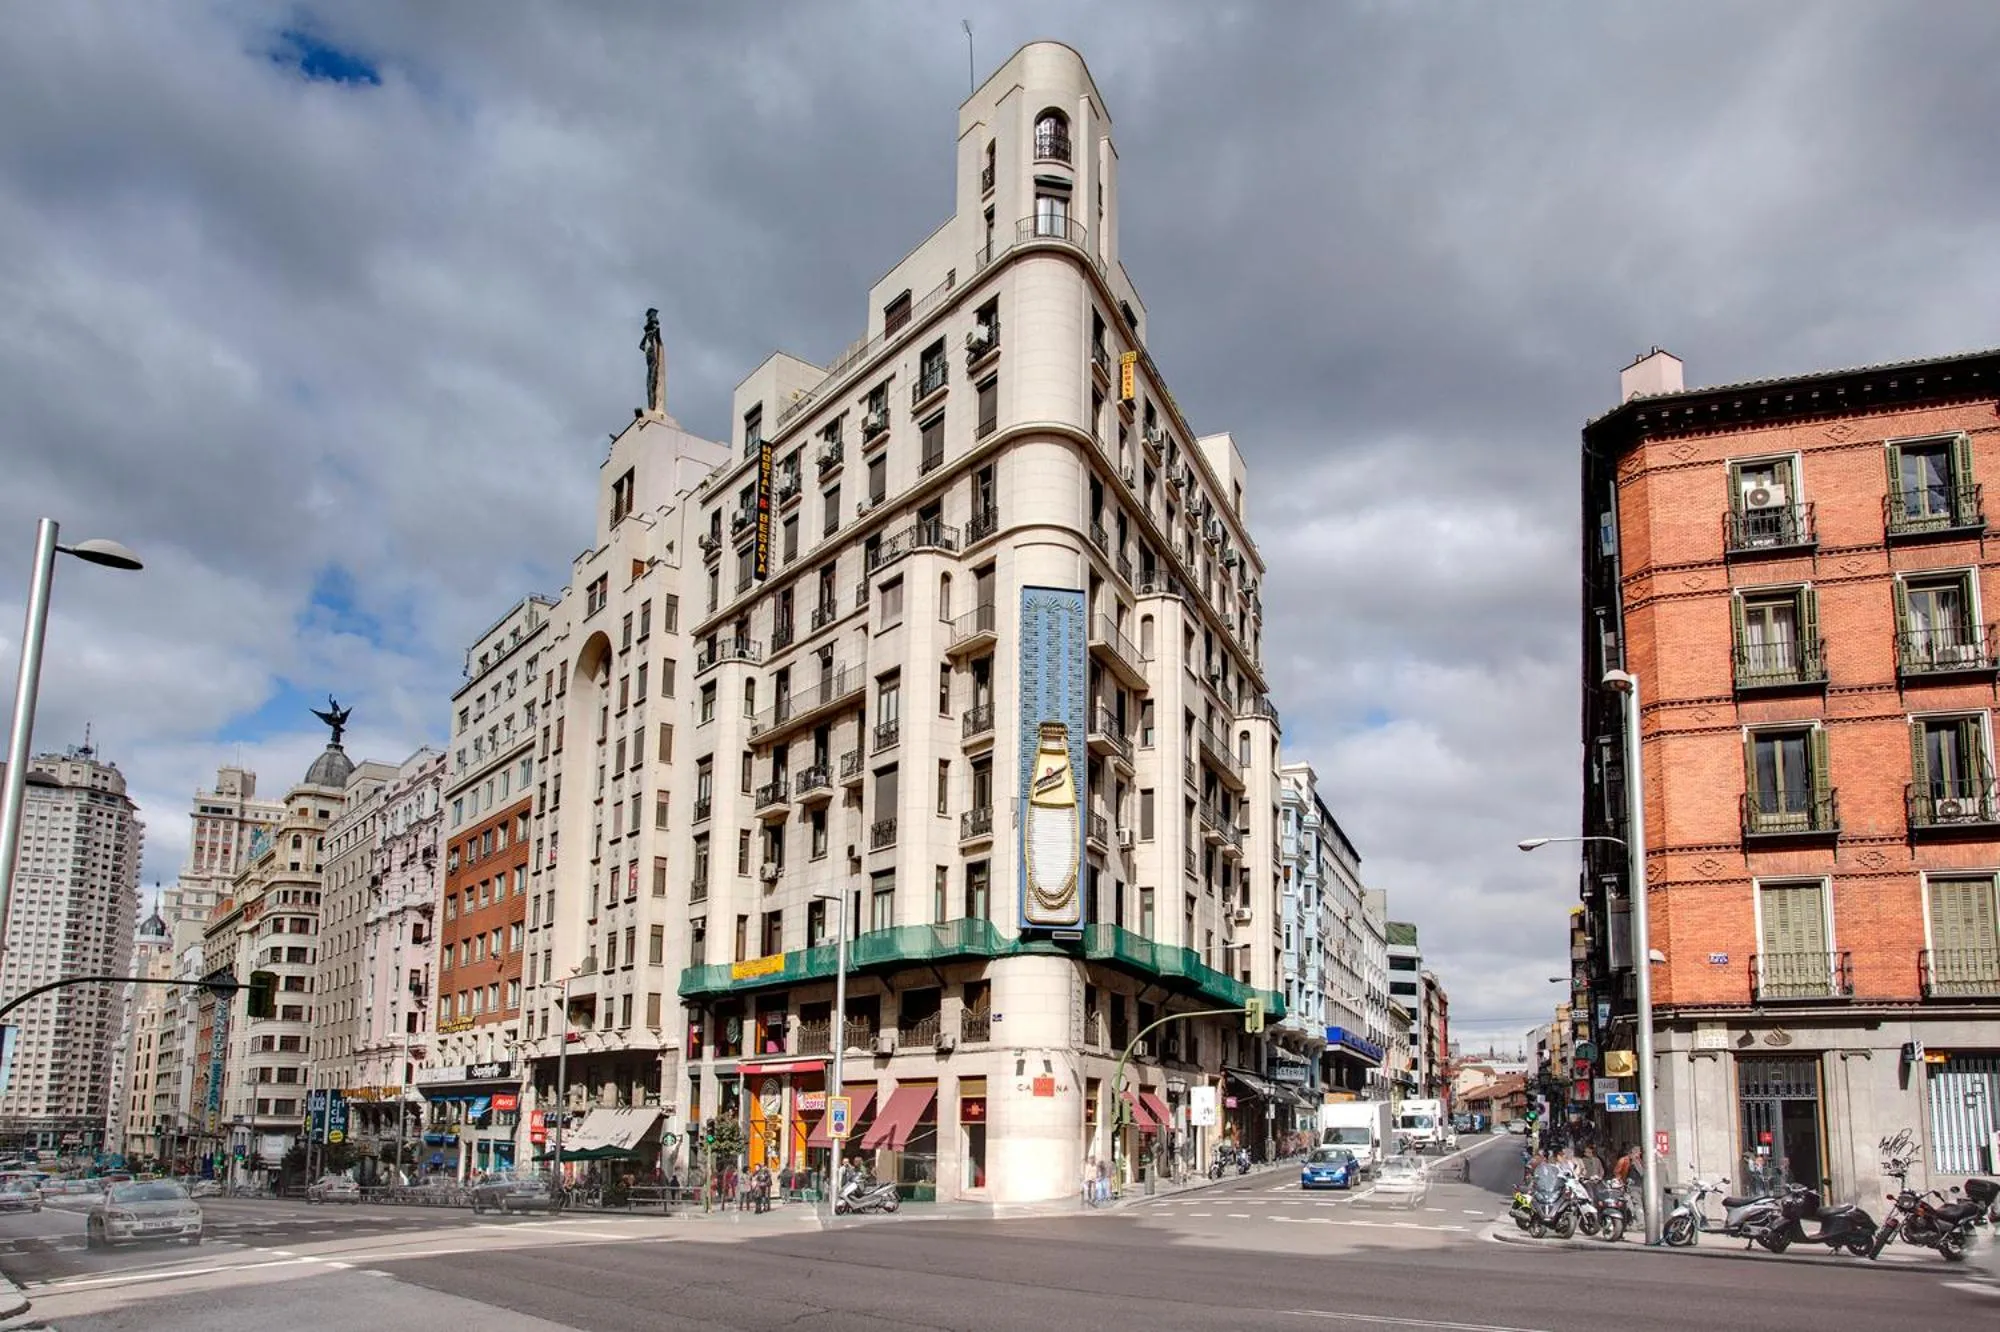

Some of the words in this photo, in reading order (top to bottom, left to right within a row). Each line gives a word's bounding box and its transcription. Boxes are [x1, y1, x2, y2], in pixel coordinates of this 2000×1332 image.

[761, 445, 772, 494] HOSTAL
[757, 513, 769, 573] BESAYA
[496, 1098, 514, 1106] AVIS
